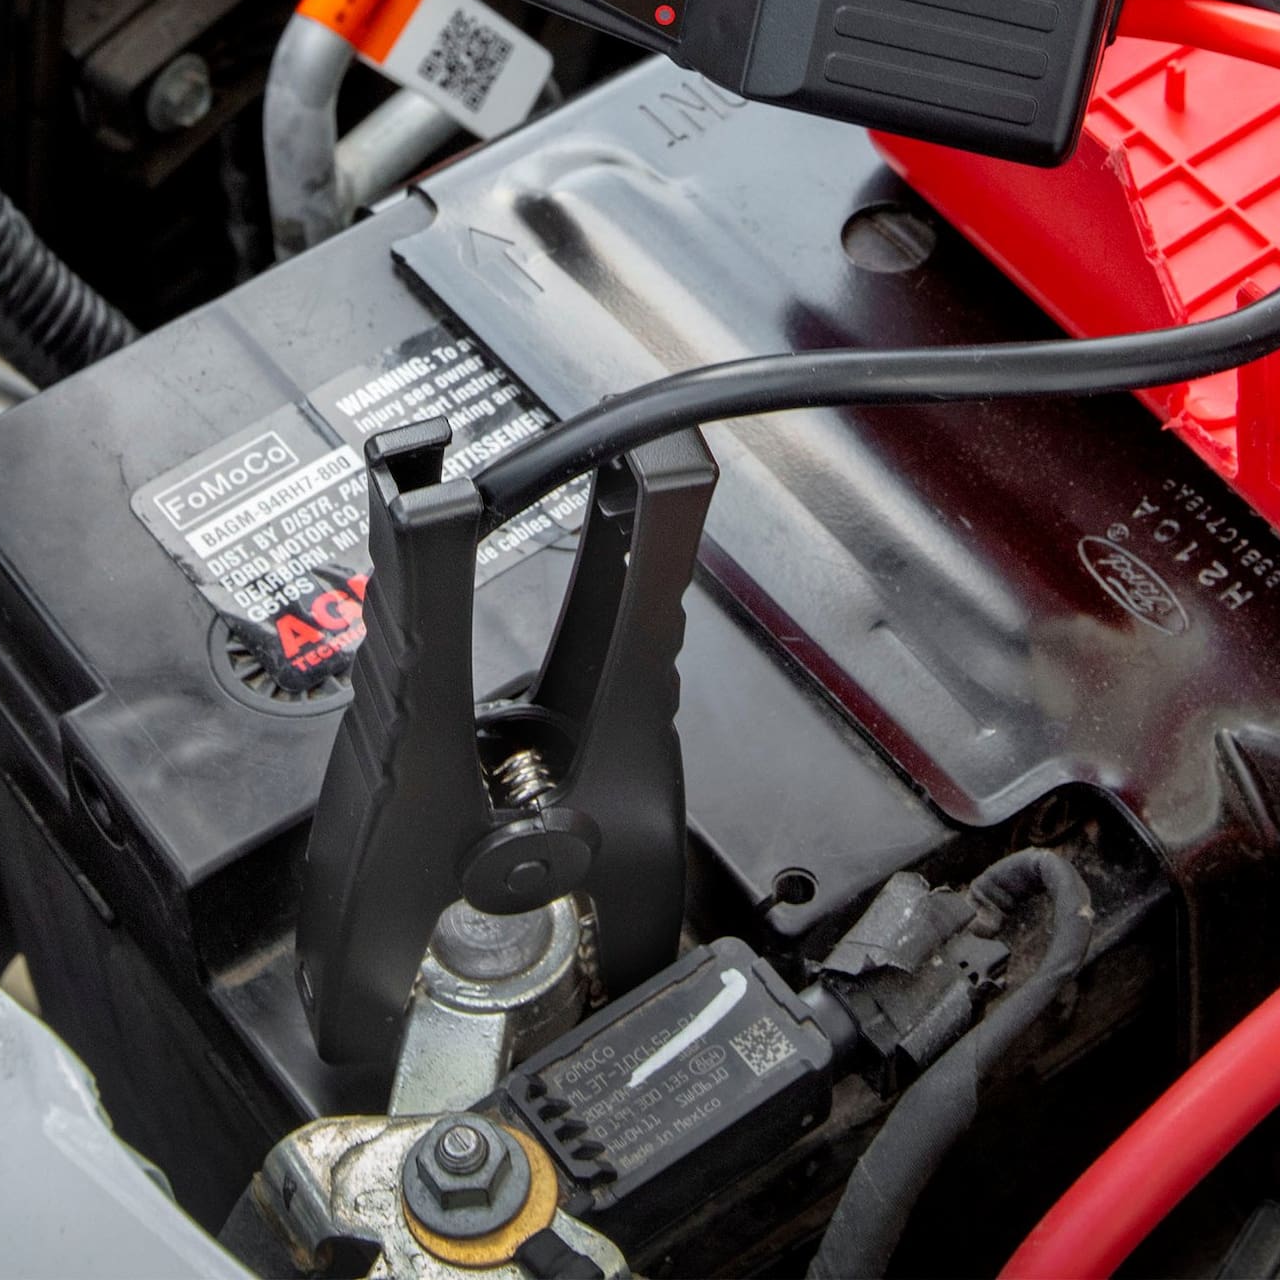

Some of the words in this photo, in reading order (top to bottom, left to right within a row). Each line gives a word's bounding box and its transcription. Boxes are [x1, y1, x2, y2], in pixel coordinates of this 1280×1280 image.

[335, 353, 434, 416] WARNING:
[432, 343, 457, 364] To
[354, 400, 405, 434] injury
[402, 383, 436, 407] see
[164, 443, 286, 520] FoMoCo
[207, 543, 252, 576] DIST.
[252, 528, 276, 551] BY
[280, 494, 340, 535] DISTR.
[220, 556, 269, 591] FORD
[269, 520, 332, 563] MOTOR
[332, 500, 366, 526] CO.
[234, 544, 336, 608] DEARBORN,
[332, 528, 360, 552] MI
[498, 513, 554, 552] cables
[553, 1044, 616, 1091] FoMoCo
[655, 1129, 673, 1146] in
[672, 1097, 721, 1132] Mexico
